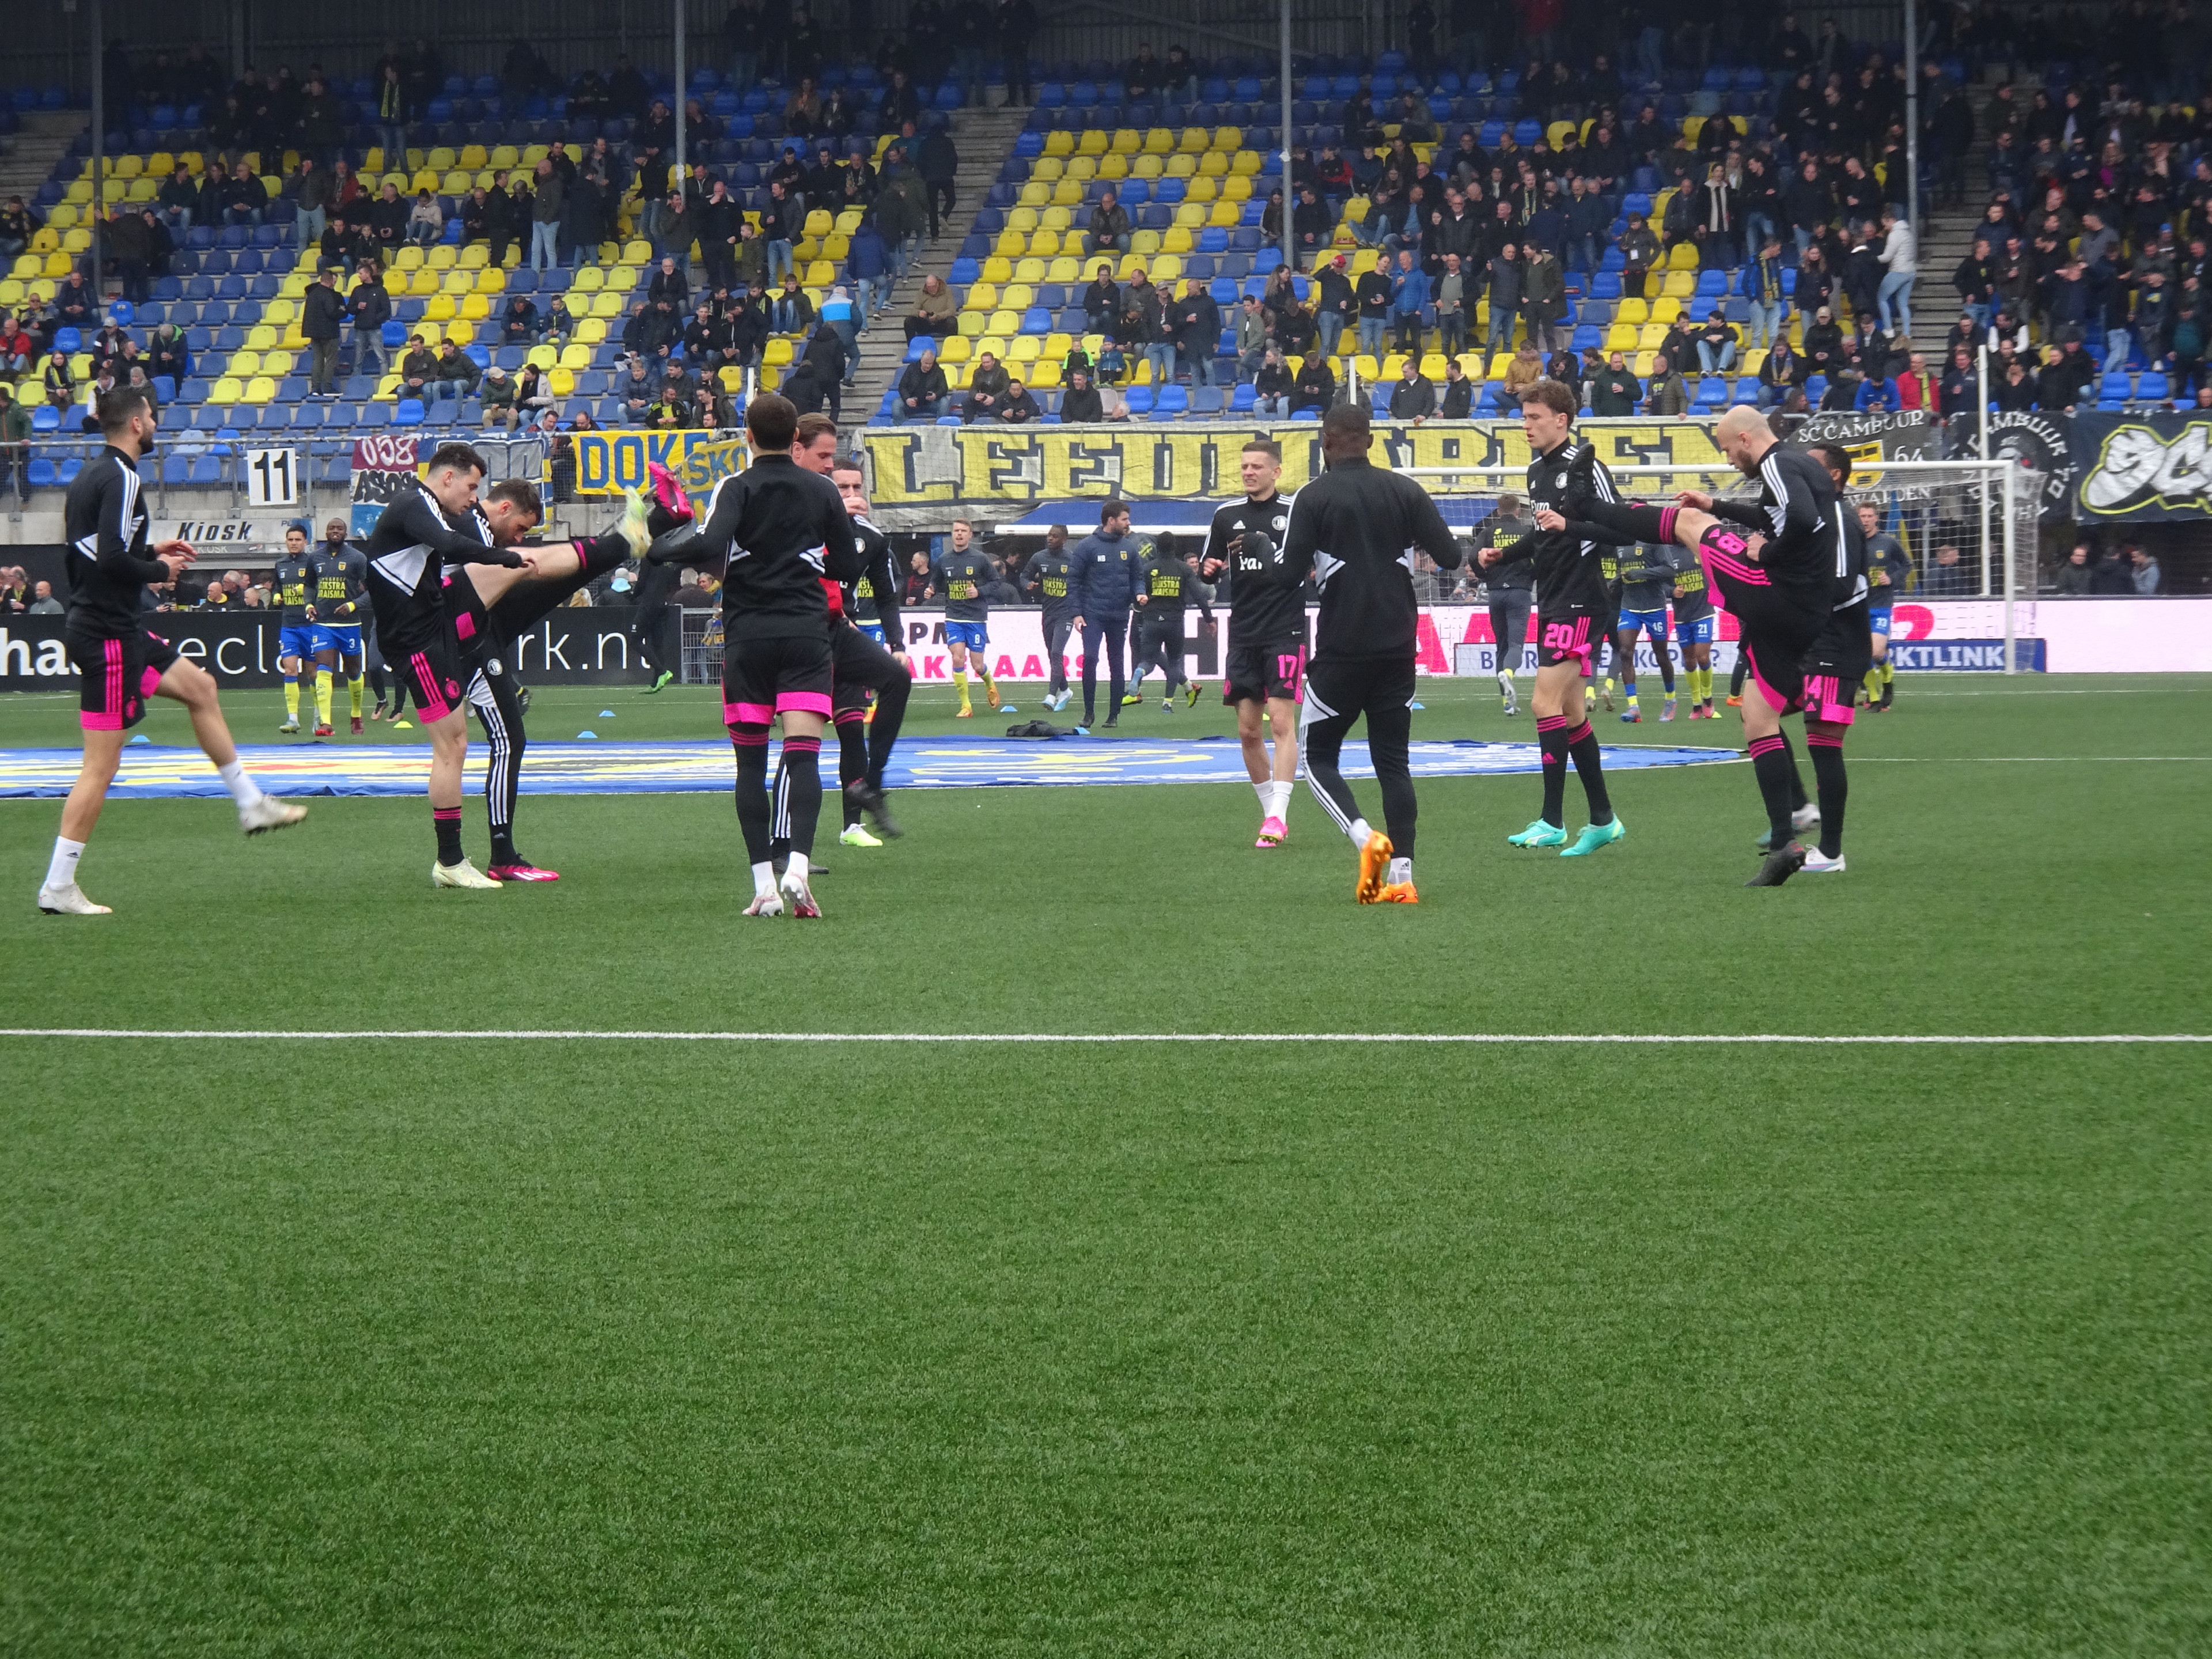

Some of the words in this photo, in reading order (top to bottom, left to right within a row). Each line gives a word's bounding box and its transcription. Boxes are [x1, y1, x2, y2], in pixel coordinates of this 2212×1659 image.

[1798, 426, 1821, 443] SC
[1824, 410, 1925, 441] CAMBUUR
[361, 435, 415, 467] 058
[254, 450, 290, 502] 11
[177, 521, 253, 541] Kiosk
[875, 631, 881, 642] 6
[974, 634, 981, 645] 8
[1544, 623, 1574, 650] 20
[1698, 623, 1708, 634] 21
[349, 638, 355, 649] 3
[1277, 654, 1298, 679] 17
